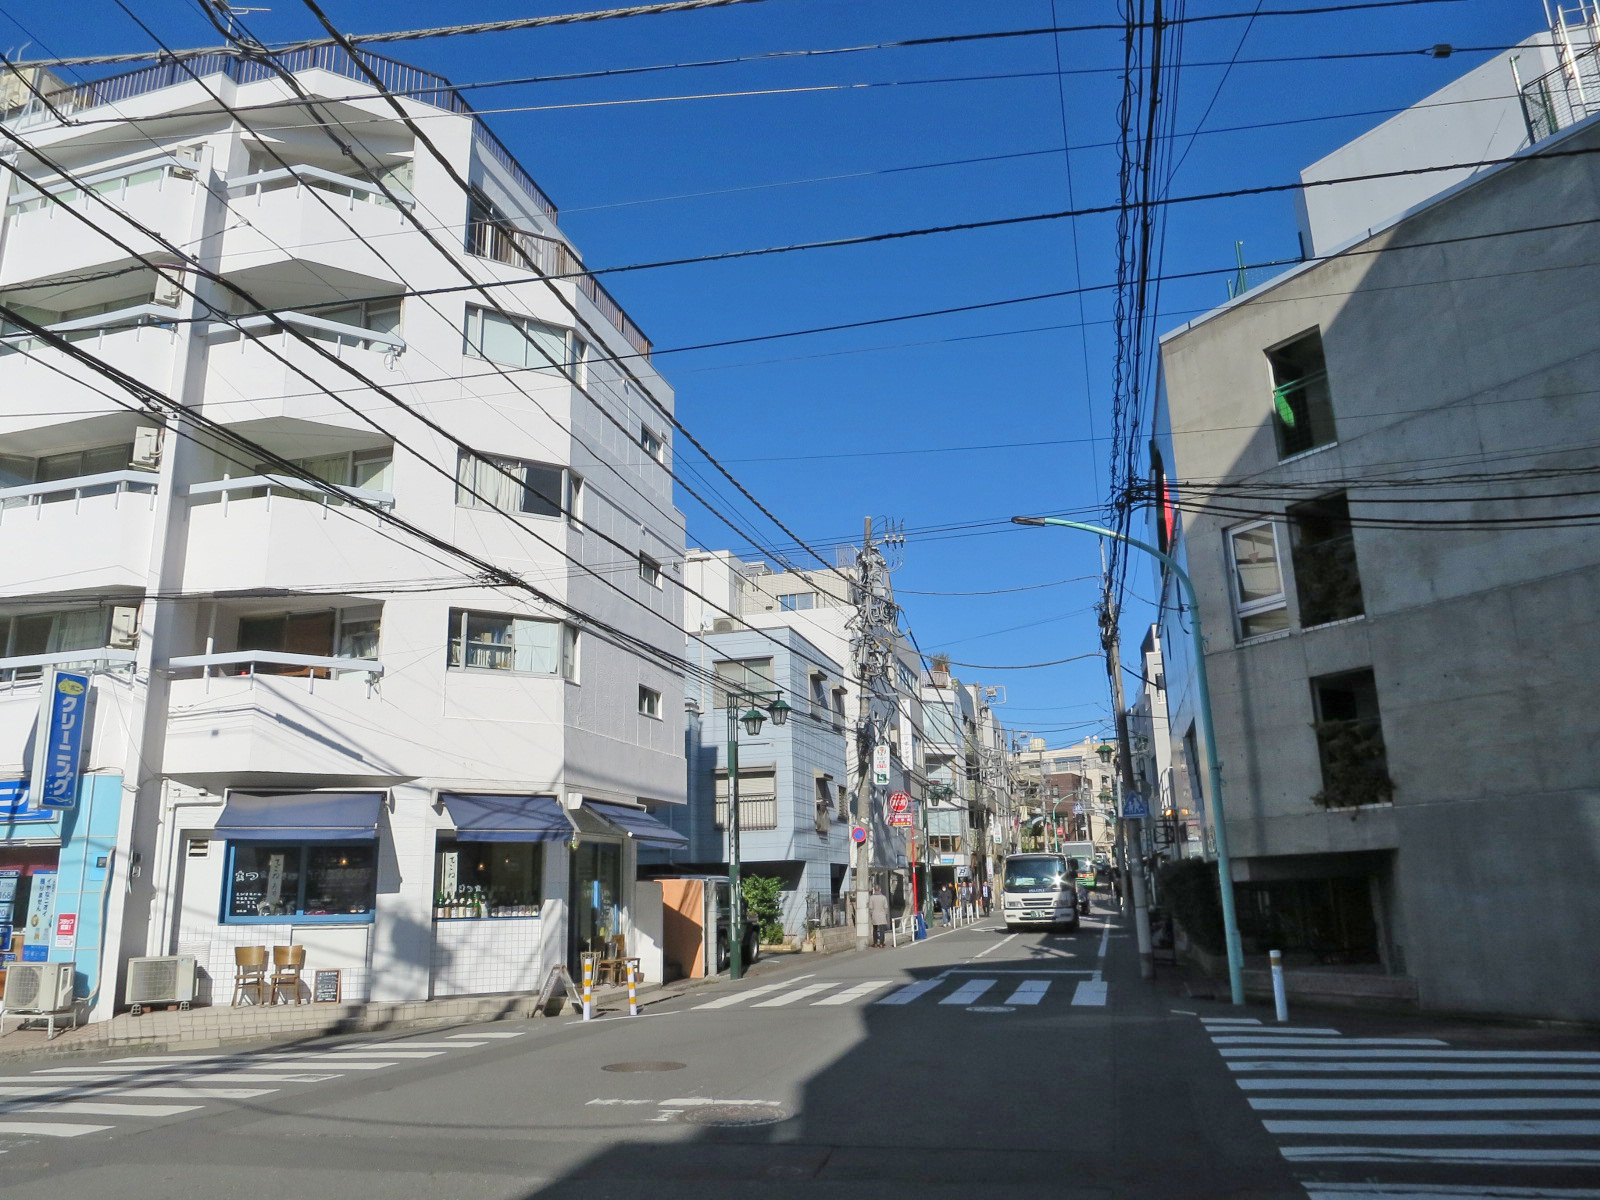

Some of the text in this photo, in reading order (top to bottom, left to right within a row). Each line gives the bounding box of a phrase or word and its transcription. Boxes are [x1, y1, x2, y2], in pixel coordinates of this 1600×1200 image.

[54, 697, 77, 795] クリーニング
